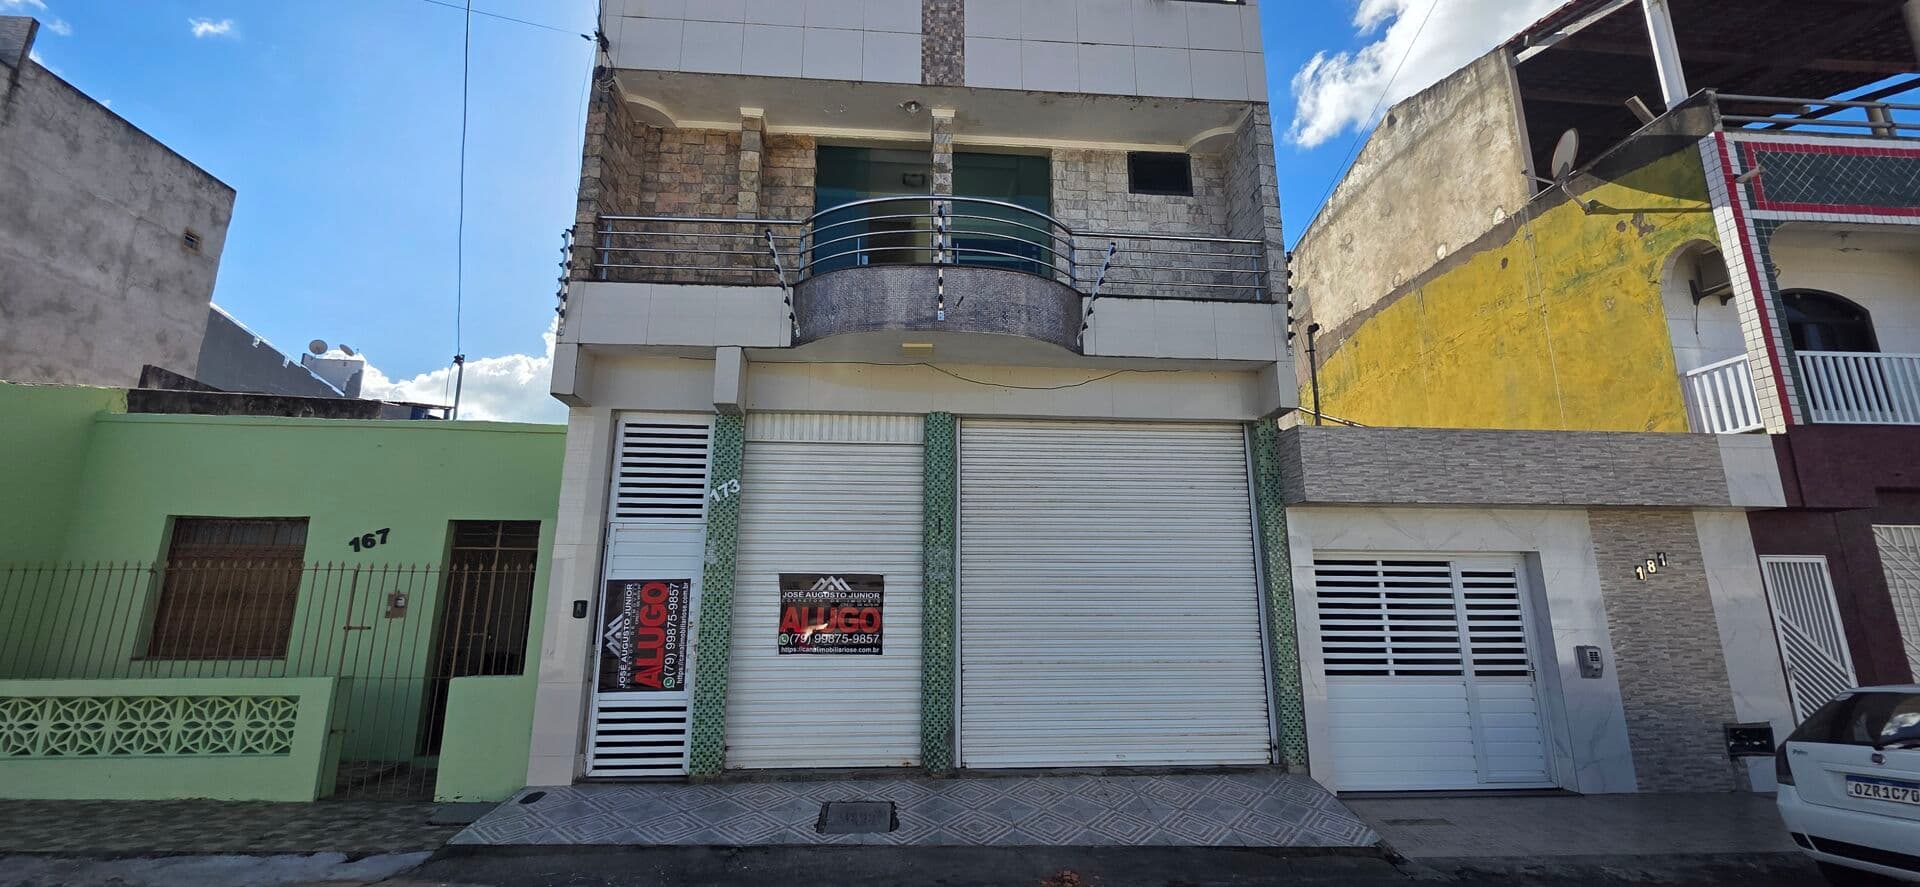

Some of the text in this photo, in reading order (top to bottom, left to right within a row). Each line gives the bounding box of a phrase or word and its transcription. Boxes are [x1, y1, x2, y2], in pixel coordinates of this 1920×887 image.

[710, 479, 740, 502] 173
[348, 527, 390, 553] 167
[1635, 552, 1667, 580] 181
[782, 590, 804, 598] JOSÉ
[805, 591, 847, 599] AUGUSTO
[664, 582, 680, 676] (79) 99875-9857
[780, 606, 881, 633] ALUGO
[619, 583, 633, 688] JOSÉ AUGUSTO JUNIOR
[635, 582, 670, 689] ALUGO
[789, 633, 880, 645] (79) 99875-9857
[1854, 783, 1920, 803] OZR1C70
